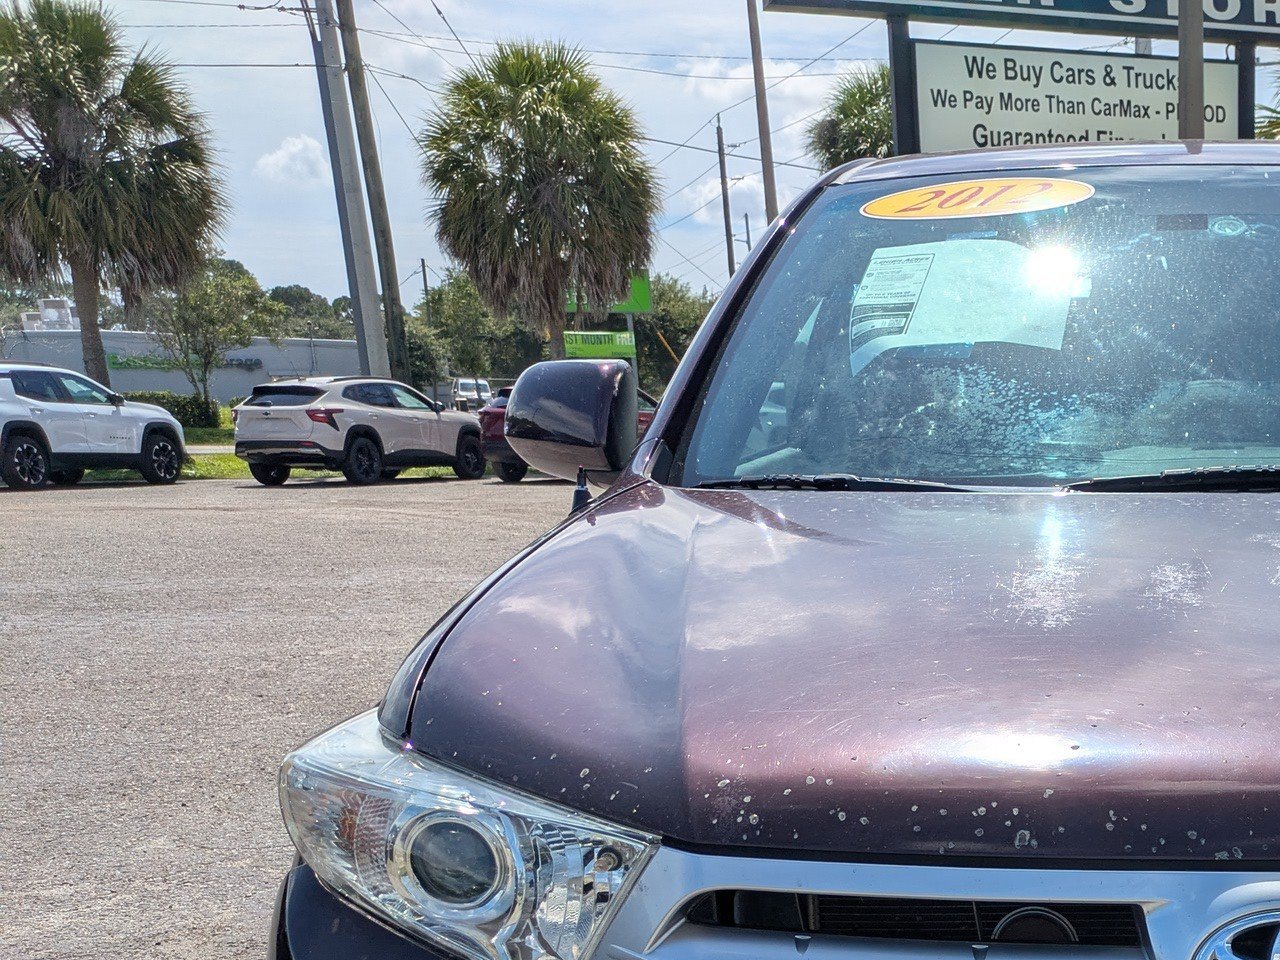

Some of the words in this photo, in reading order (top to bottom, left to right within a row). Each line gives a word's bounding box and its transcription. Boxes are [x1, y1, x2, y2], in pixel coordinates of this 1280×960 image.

[964, 55, 997, 80] We
[1004, 58, 1043, 88] Buy
[1050, 61, 1096, 86] Cars
[1103, 64, 1117, 87] &
[1122, 66, 1180, 91] Truck
[930, 88, 958, 108] We
[963, 90, 994, 115] Pay
[1000, 92, 1040, 113] More
[1045, 95, 1086, 115] Than
[1091, 97, 1150, 119] CarMax
[1166, 102, 1226, 123] POD
